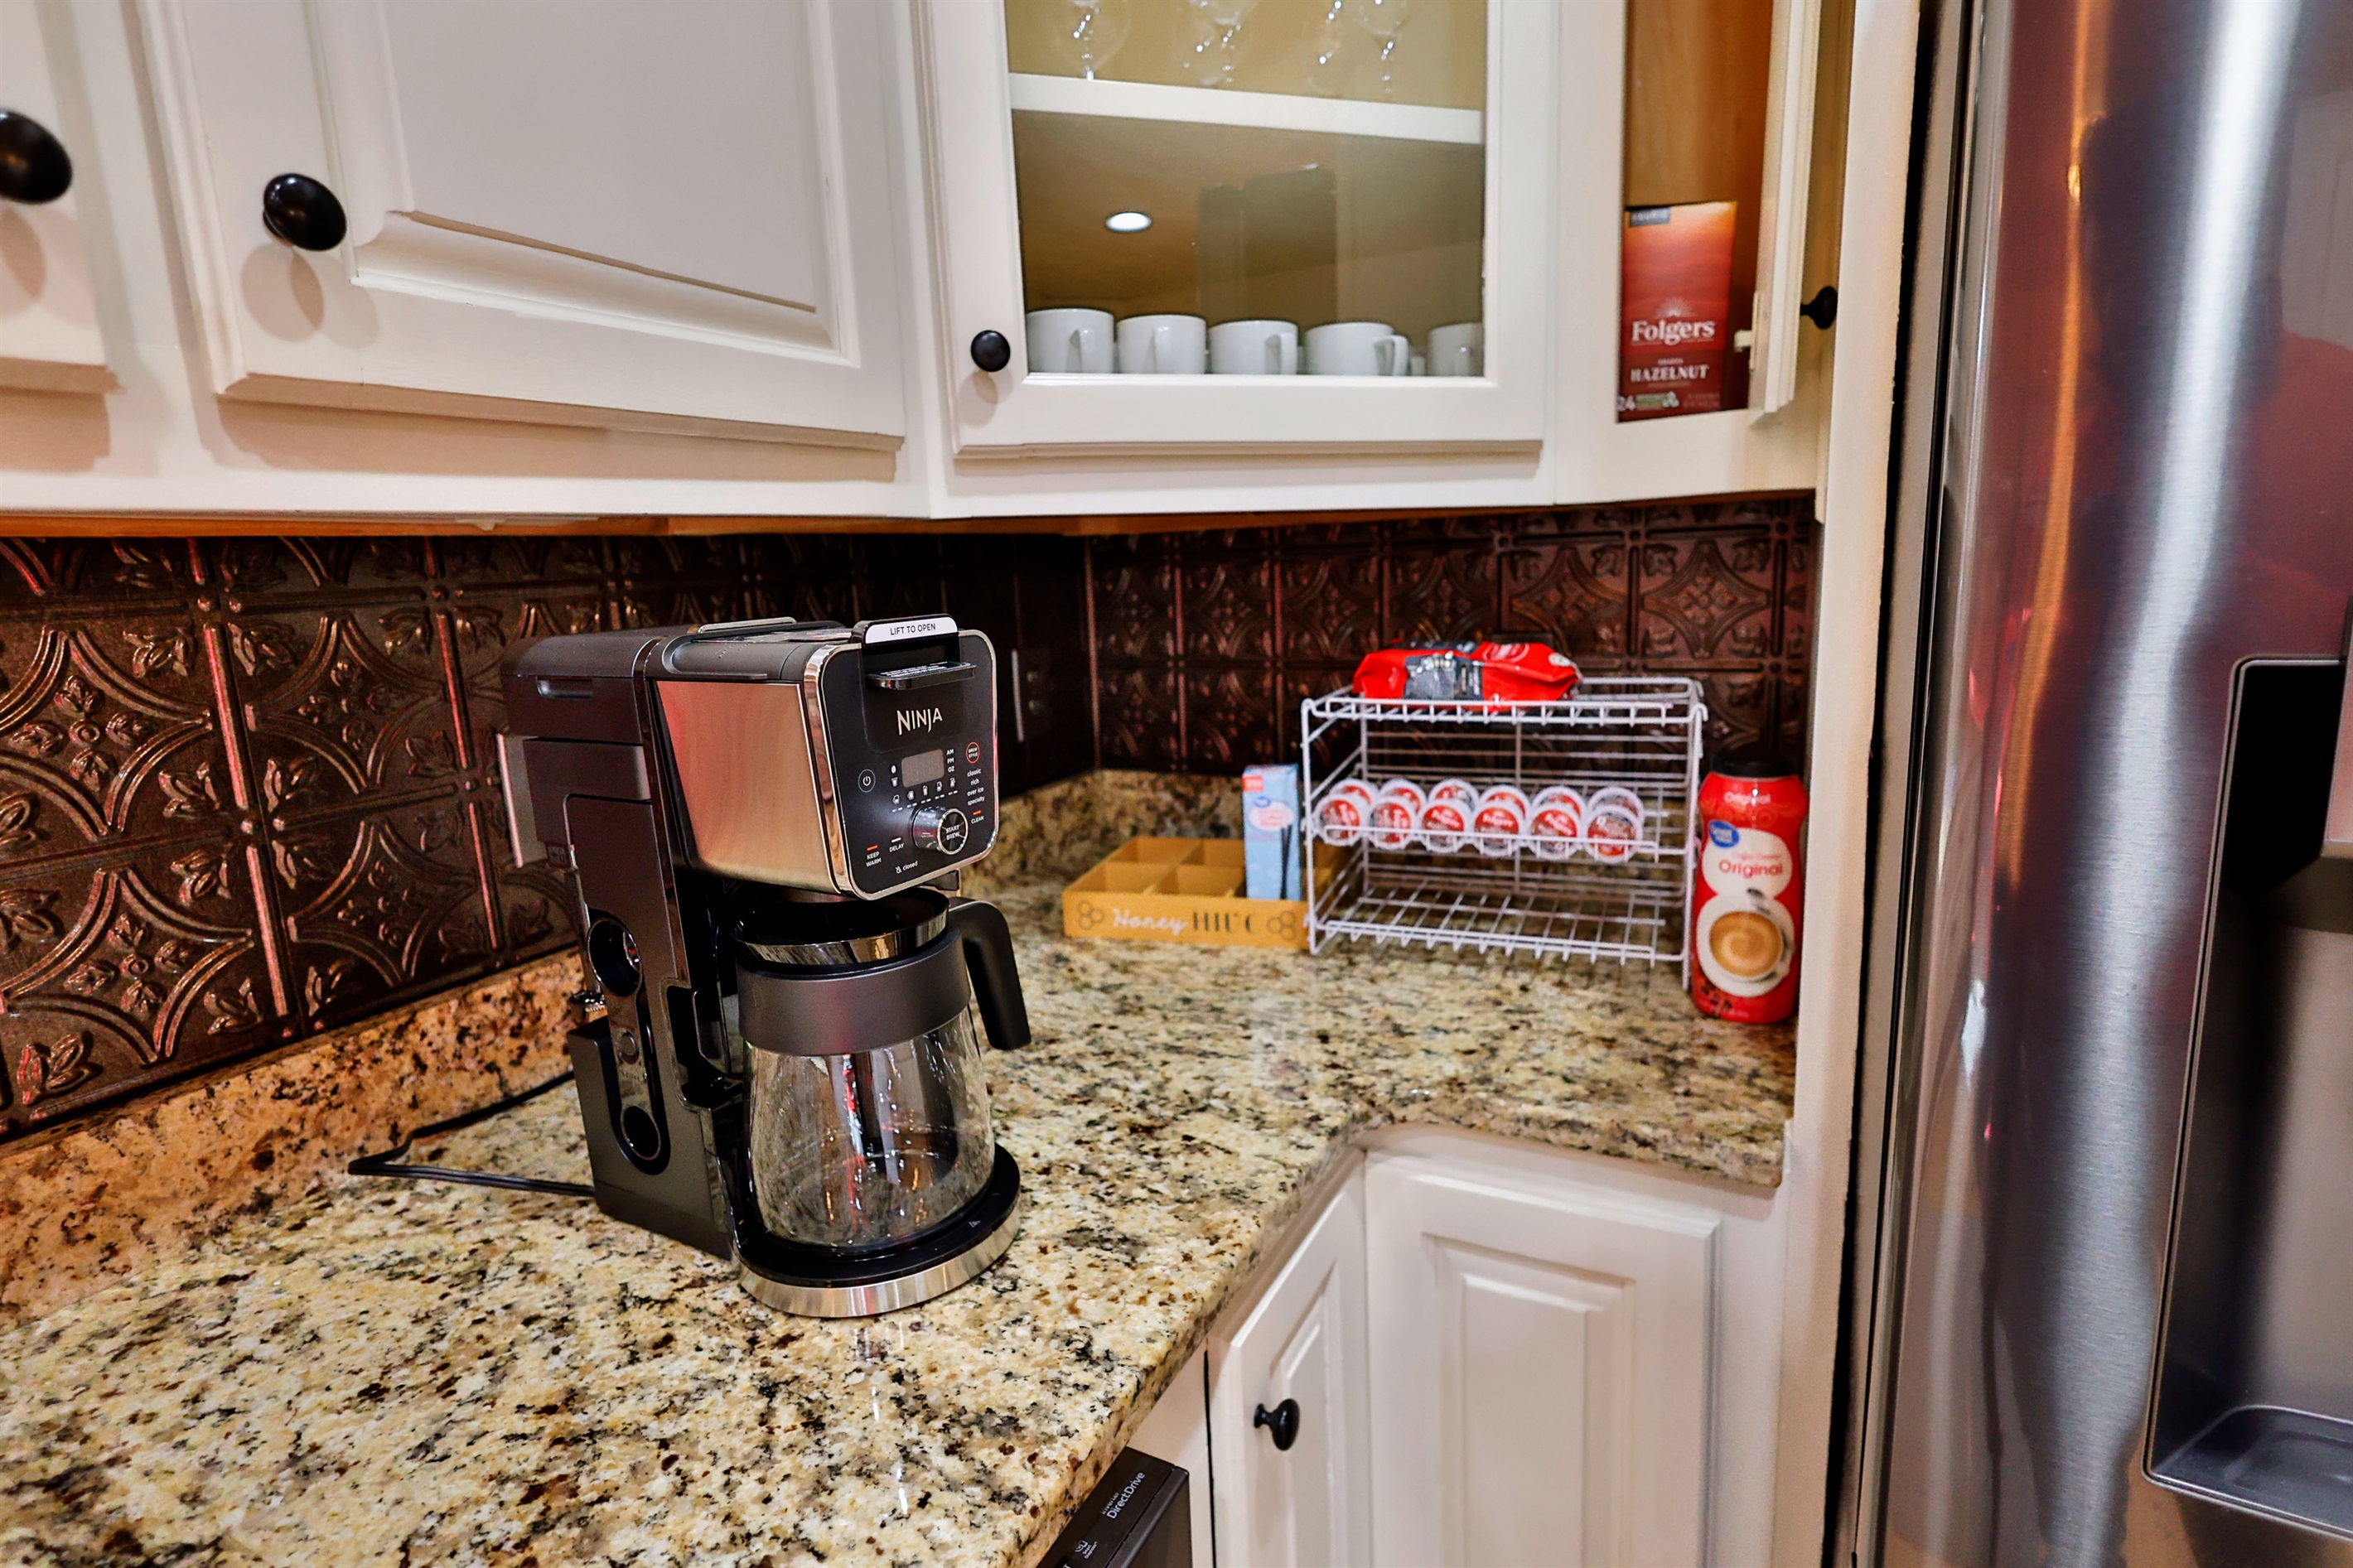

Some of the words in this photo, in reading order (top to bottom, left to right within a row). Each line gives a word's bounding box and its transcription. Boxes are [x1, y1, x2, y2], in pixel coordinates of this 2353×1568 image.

[1631, 320, 1716, 346] Folgers
[1630, 364, 1710, 383] HAZELNUT
[890, 625, 905, 635] LIFT
[906, 625, 916, 634] TO
[917, 623, 936, 632] OPEN
[896, 707, 943, 736] NINJA
[967, 768, 982, 777] classic
[967, 788, 978, 797] over
[967, 796, 986, 806] specialty
[970, 816, 984, 824] CLEAN
[945, 824, 960, 834] START
[946, 832, 960, 841] BREW
[889, 843, 905, 852] DELAY
[867, 851, 880, 860] KEEP
[866, 858, 882, 867] WARM
[902, 861, 918, 871] closed
[1718, 858, 1783, 880] Original
[1111, 907, 1189, 937] Honey
[1107, 1472, 1145, 1519] DirectDrive
